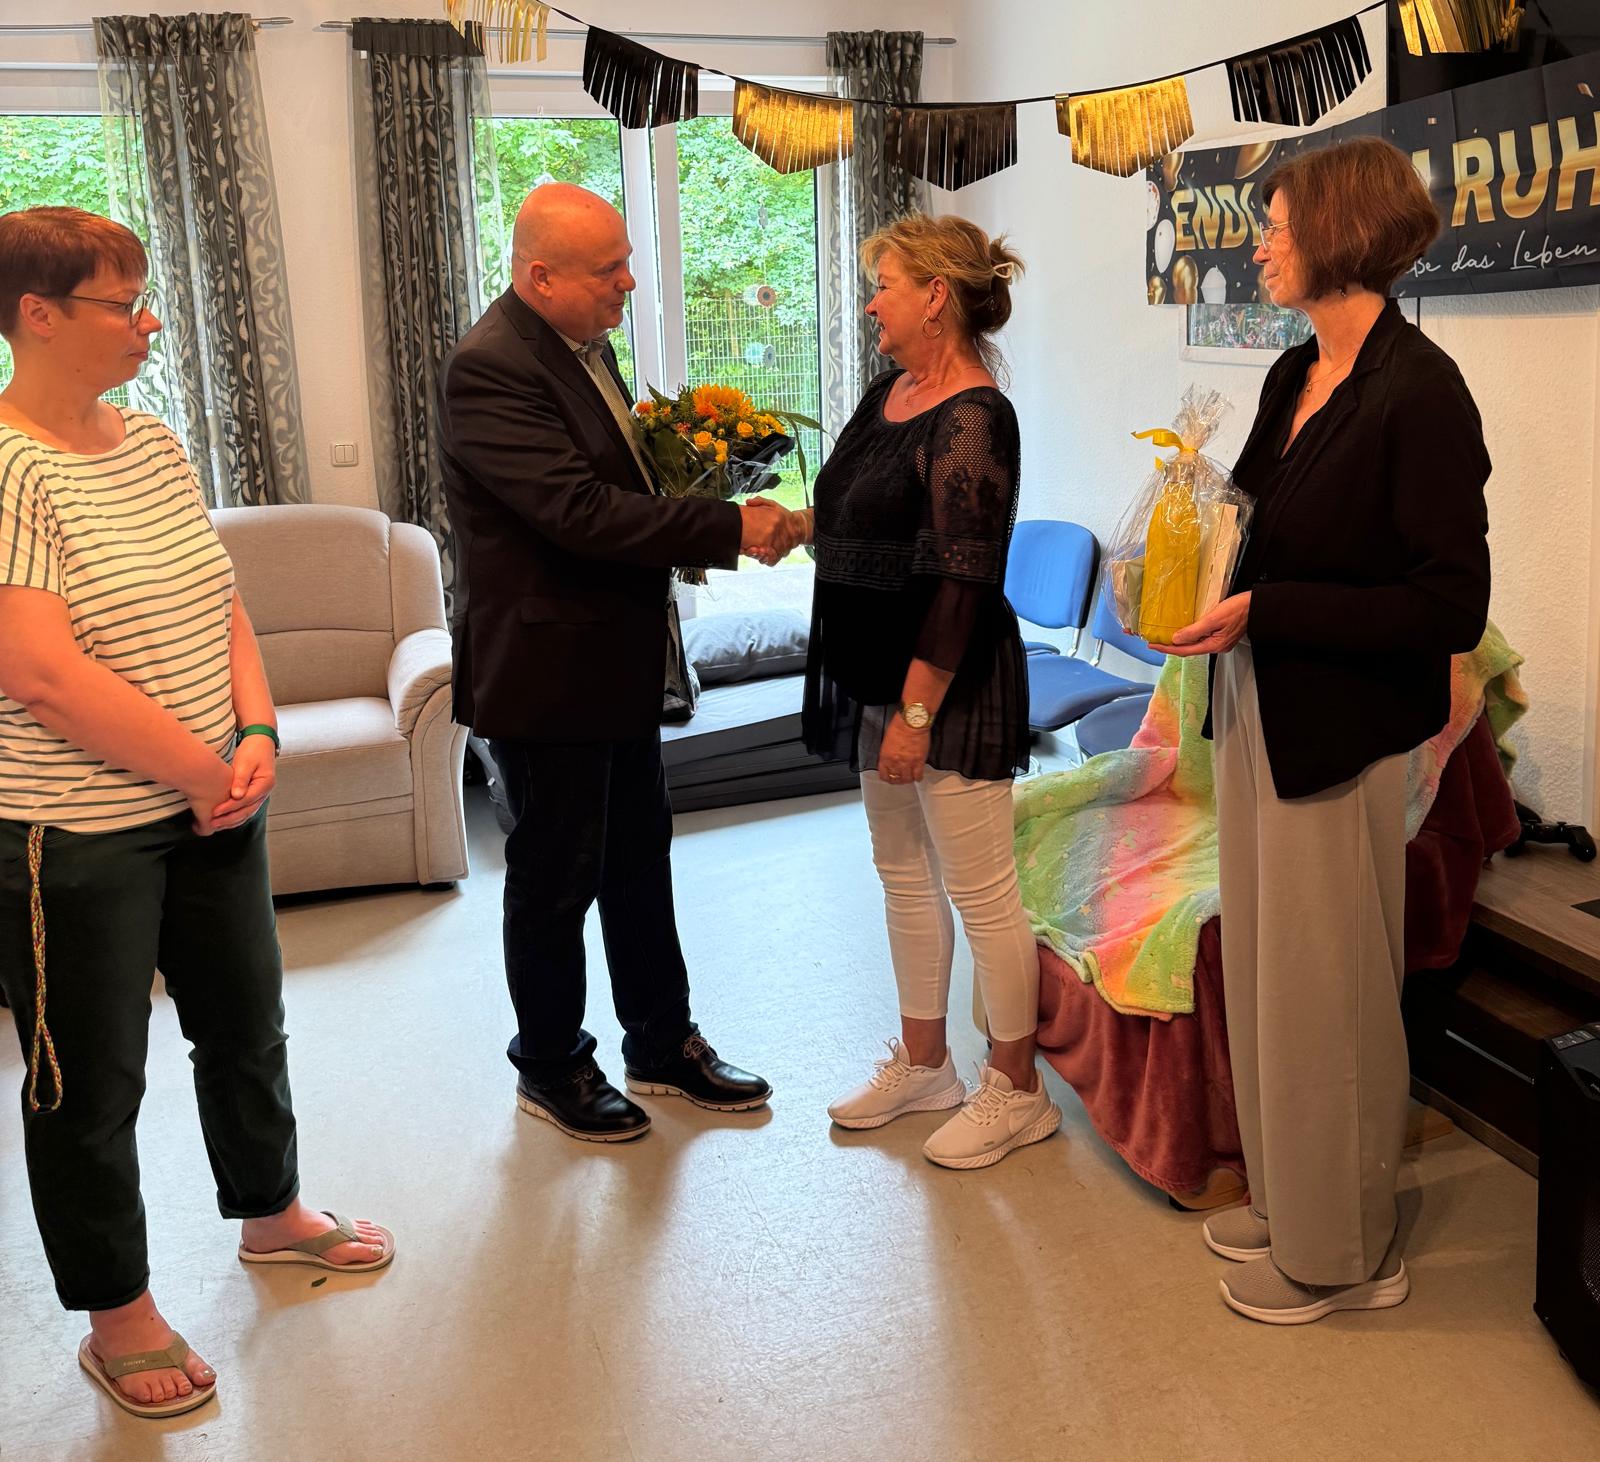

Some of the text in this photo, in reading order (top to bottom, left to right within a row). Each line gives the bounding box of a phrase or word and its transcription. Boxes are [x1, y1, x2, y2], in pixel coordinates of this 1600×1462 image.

[1171, 182, 1263, 252] ENDL
[1451, 245, 1495, 272] das
[1510, 230, 1597, 269] Leben
